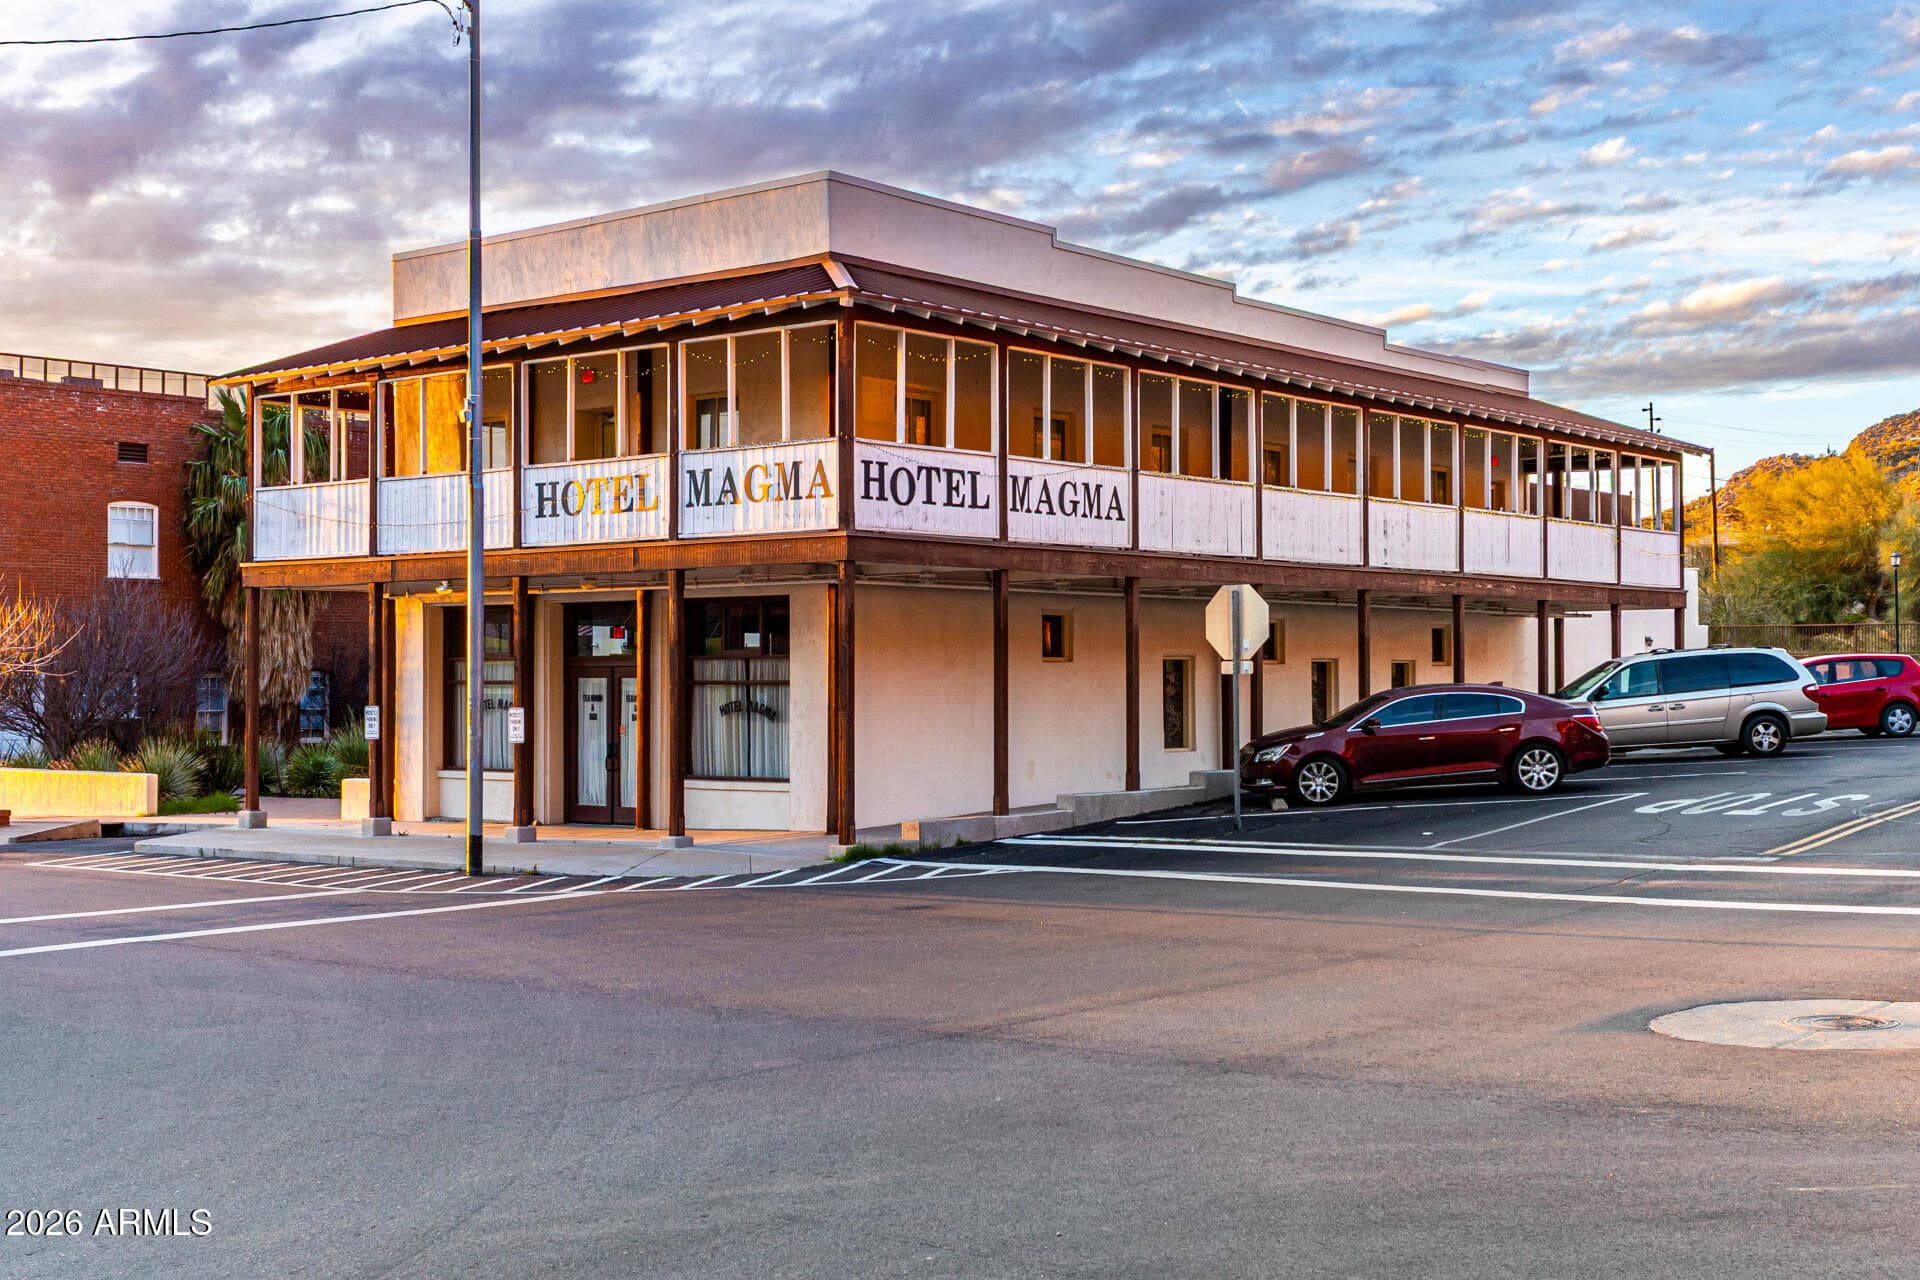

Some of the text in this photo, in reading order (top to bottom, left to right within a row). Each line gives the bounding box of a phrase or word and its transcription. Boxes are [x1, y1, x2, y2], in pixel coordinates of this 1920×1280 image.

[535, 458, 835, 519] HOTEL MAGMA
[860, 459, 1126, 522] HOTEL MAGMA
[719, 700, 777, 723] HOTEL MAGMA
[1634, 792, 1870, 816] STOP
